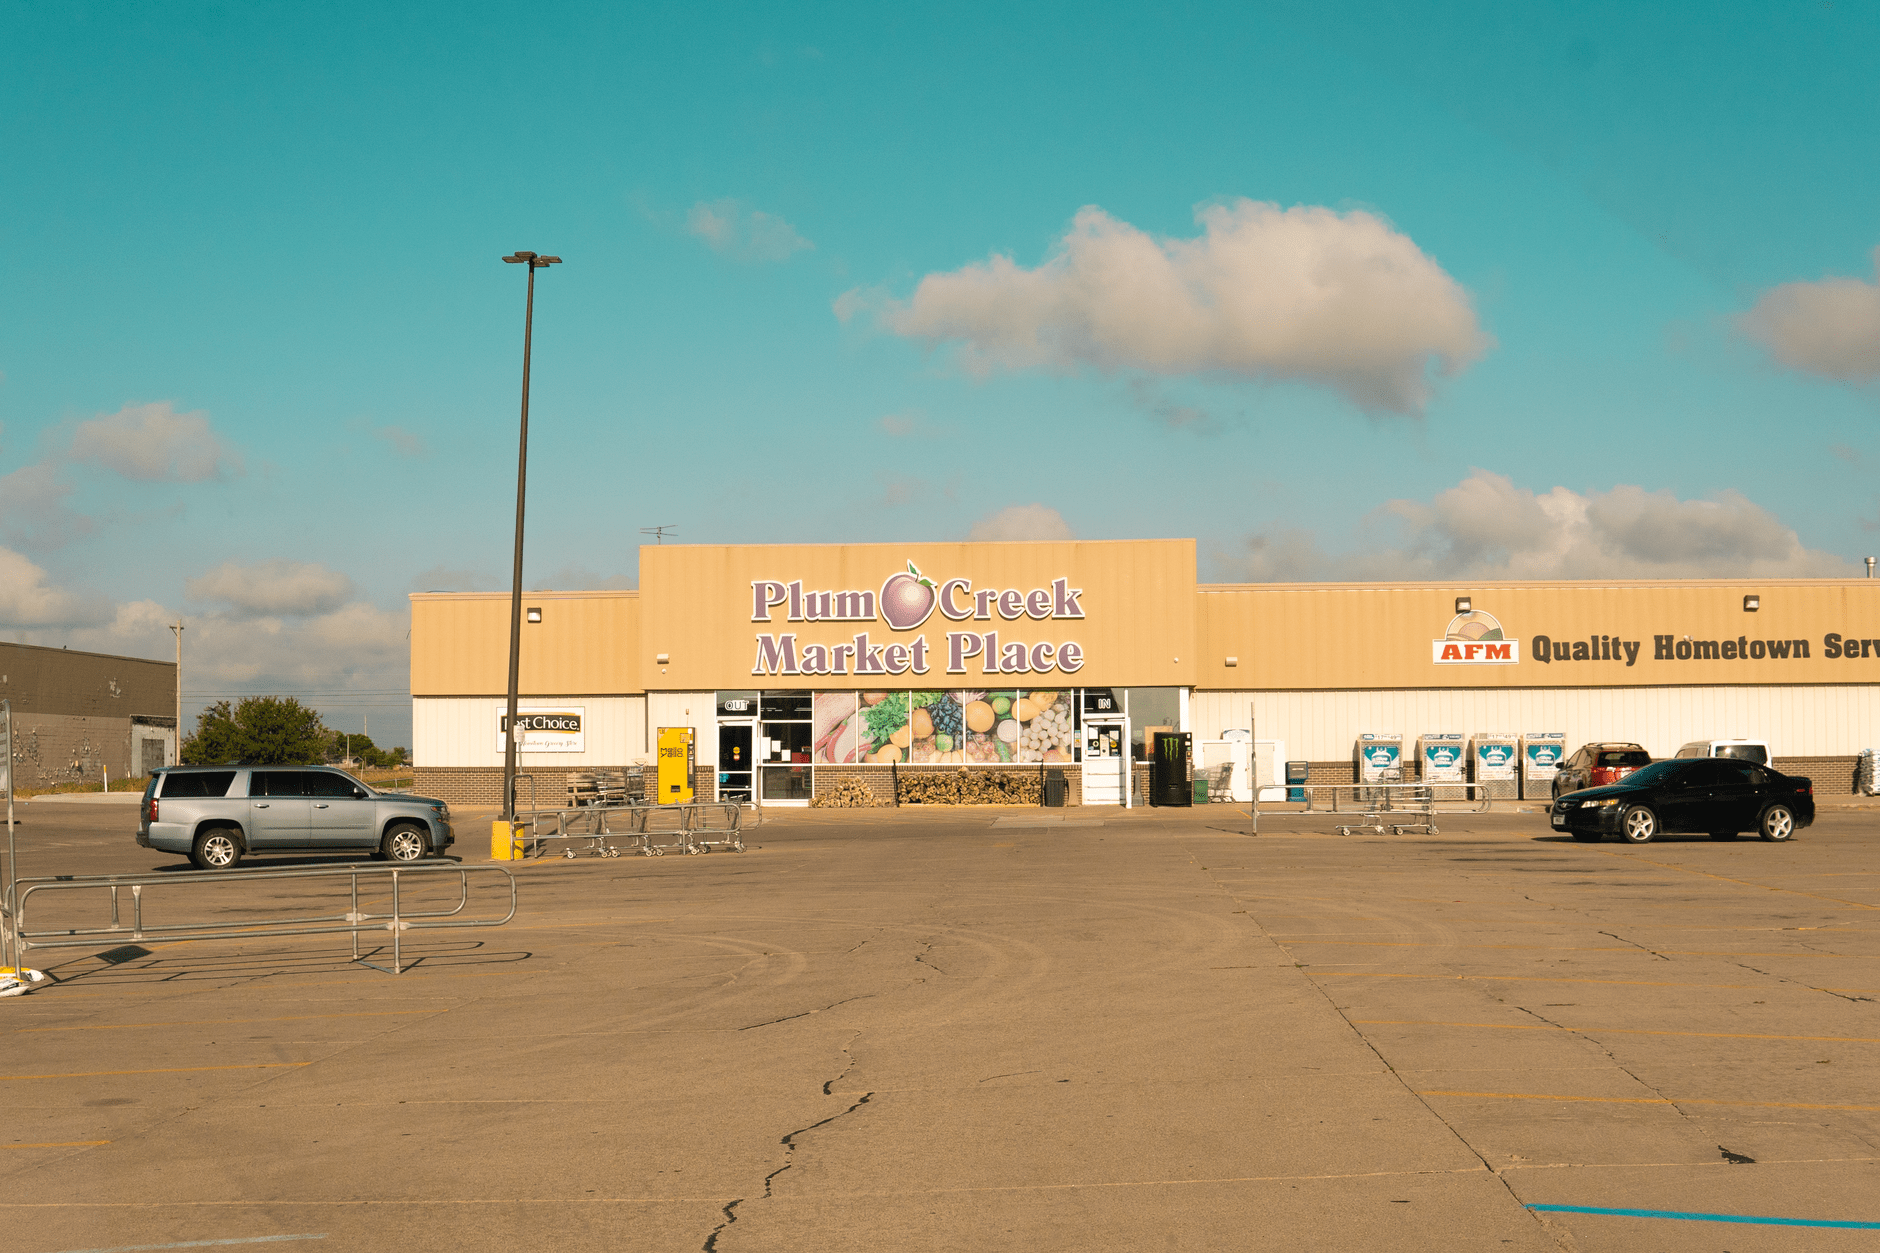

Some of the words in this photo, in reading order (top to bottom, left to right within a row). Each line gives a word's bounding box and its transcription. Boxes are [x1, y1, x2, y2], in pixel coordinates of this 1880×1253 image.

[751, 580, 877, 621] Plum
[938, 577, 1085, 620] Creek
[752, 632, 930, 675] Market
[946, 631, 1085, 675] Place
[1441, 644, 1512, 660] AFM
[1532, 635, 1640, 666] Quality
[1654, 634, 1811, 660] Hometown
[725, 700, 749, 711] OUT
[1098, 698, 1111, 709] IN
